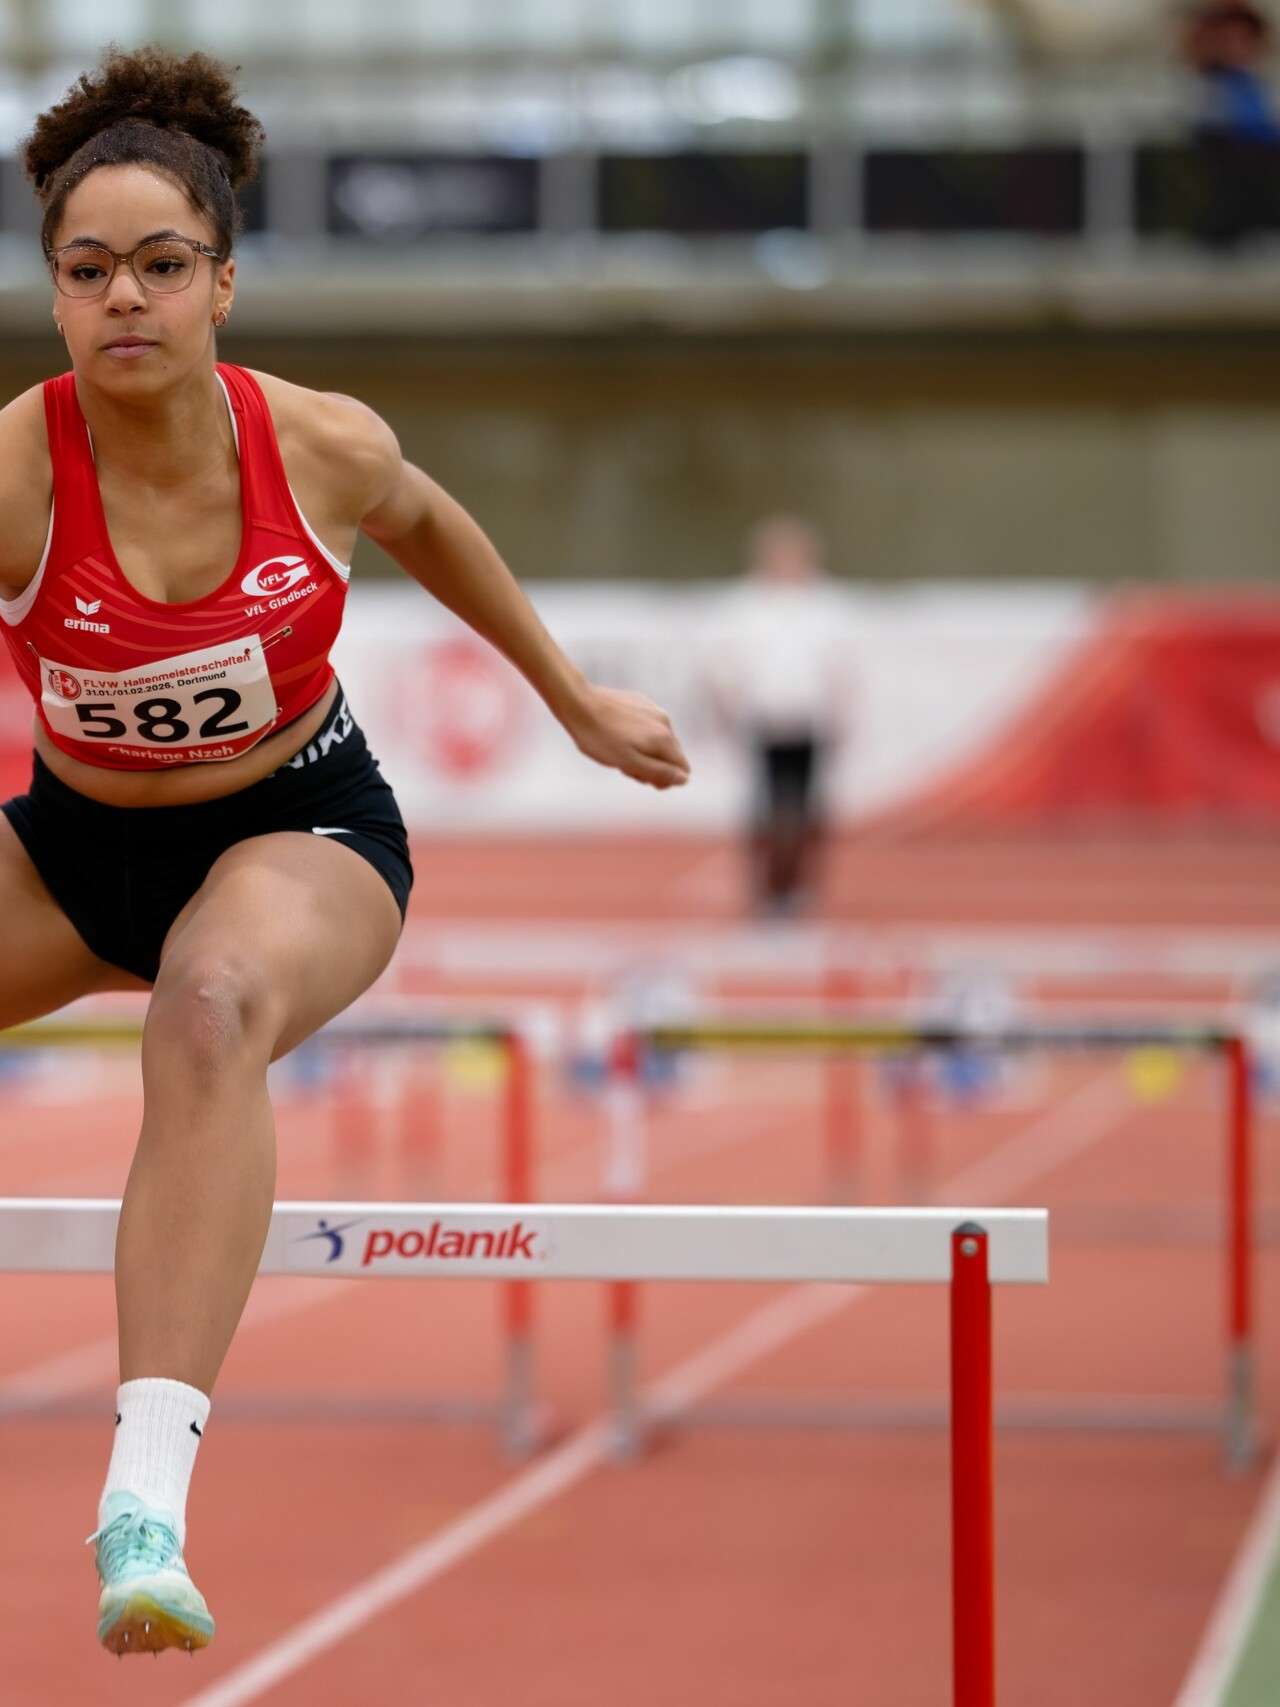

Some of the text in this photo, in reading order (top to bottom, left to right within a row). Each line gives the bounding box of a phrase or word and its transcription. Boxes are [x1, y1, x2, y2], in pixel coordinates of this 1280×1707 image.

[243, 582, 319, 618] VfL Gladbeck
[63, 617, 110, 634] erima
[83, 679, 119, 689] FLVW
[123, 655, 251, 688] Hallenmeisterschaften
[177, 671, 227, 687] Dortmund
[74, 687, 250, 743] 582
[188, 746, 235, 759] Nzeh
[361, 1220, 538, 1267] polanik
